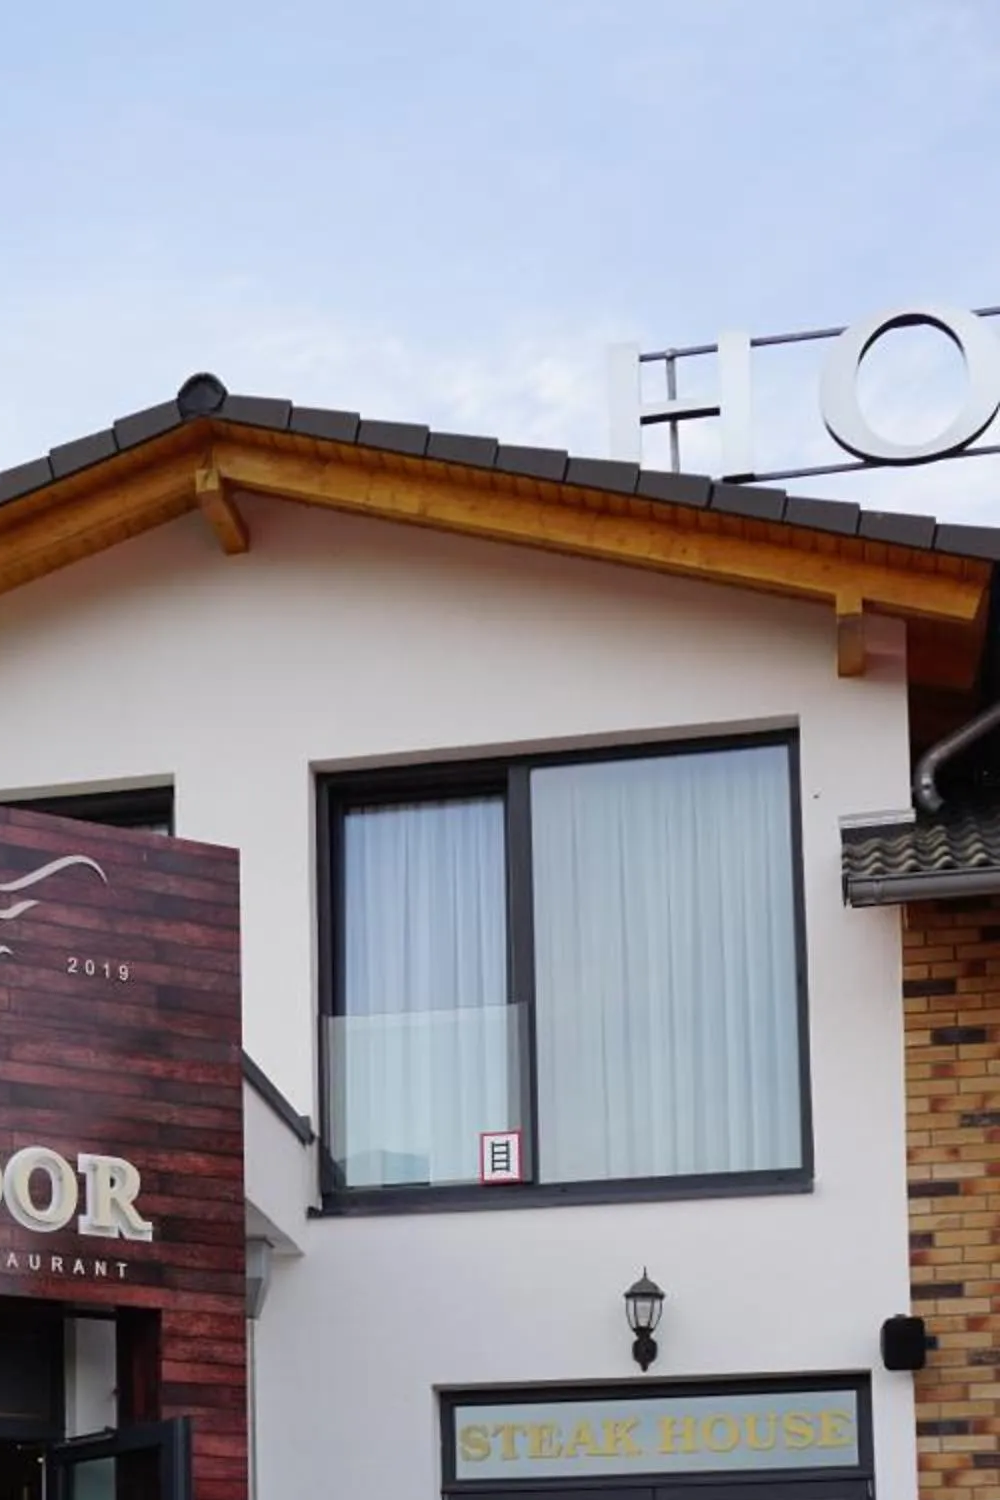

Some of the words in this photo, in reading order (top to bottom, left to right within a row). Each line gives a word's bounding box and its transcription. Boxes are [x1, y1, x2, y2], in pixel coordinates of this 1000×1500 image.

[66, 956, 131, 982] 2019
[459, 1416, 643, 1463] STEAK
[657, 1409, 853, 1455] HOUSE
